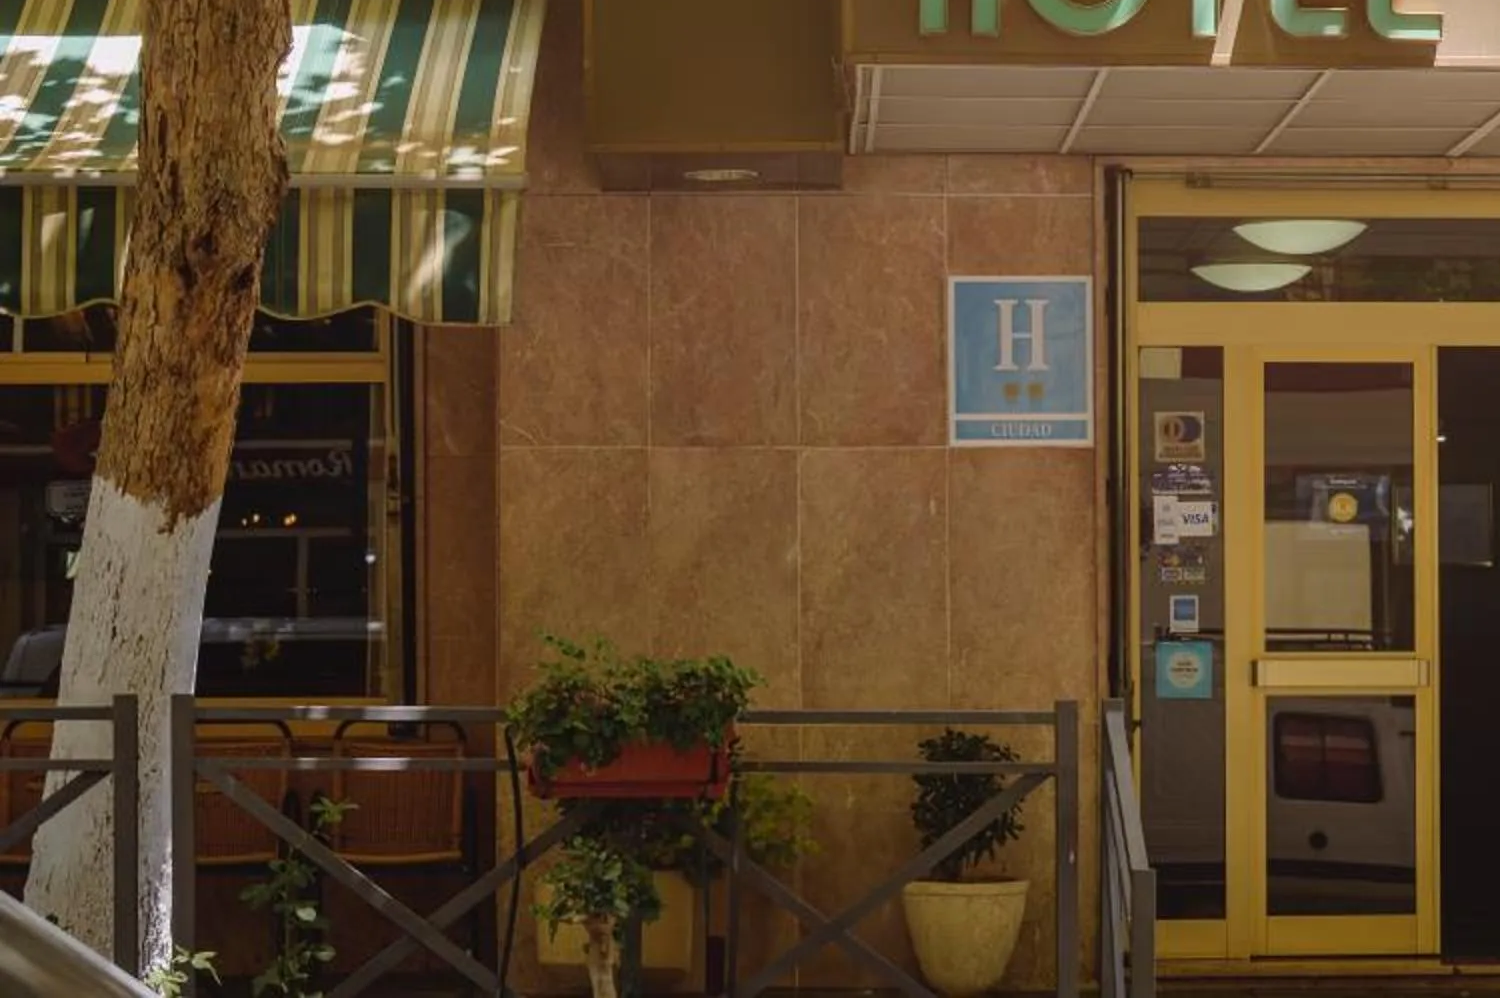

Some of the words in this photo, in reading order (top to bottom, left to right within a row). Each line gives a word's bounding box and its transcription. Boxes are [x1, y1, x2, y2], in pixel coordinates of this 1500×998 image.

[993, 298, 1050, 372] H
[990, 423, 1052, 438] CIUDAD
[1182, 513, 1209, 525] VISA
